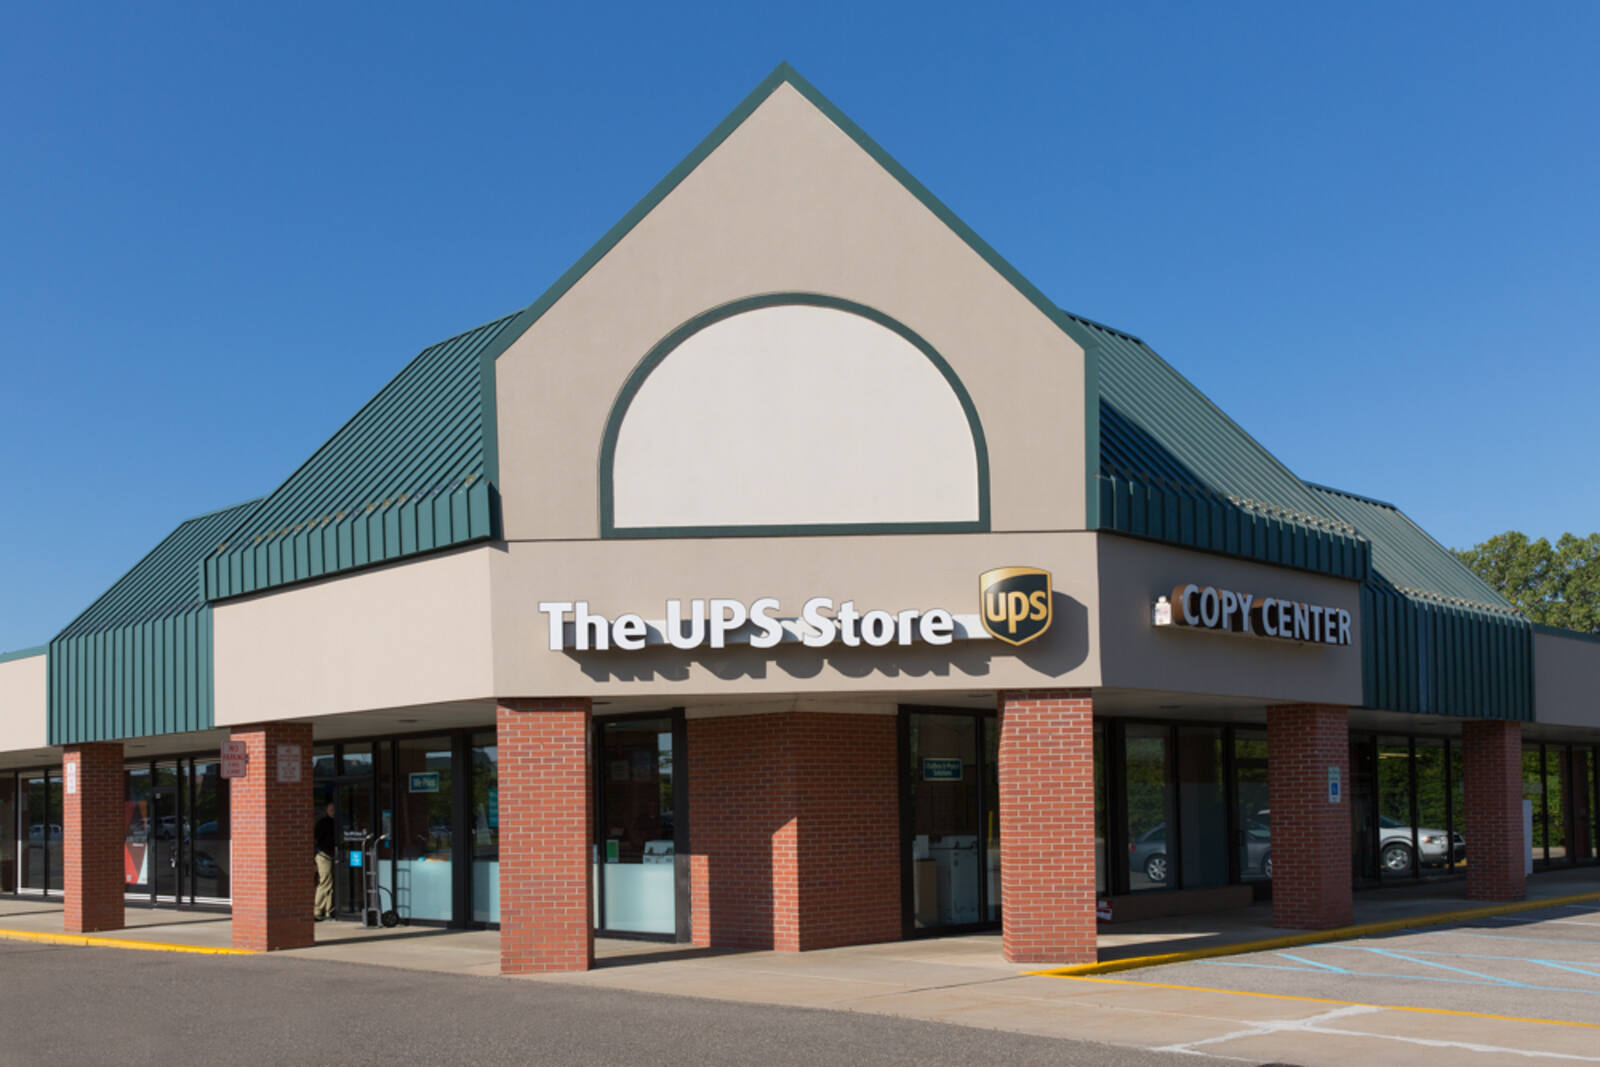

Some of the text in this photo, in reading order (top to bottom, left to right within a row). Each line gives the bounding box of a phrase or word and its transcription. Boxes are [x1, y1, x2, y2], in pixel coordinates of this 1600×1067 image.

[538, 597, 955, 651] The UPS Store
[985, 589, 1048, 624] ups
[1182, 583, 1351, 645] COPY CENTER
